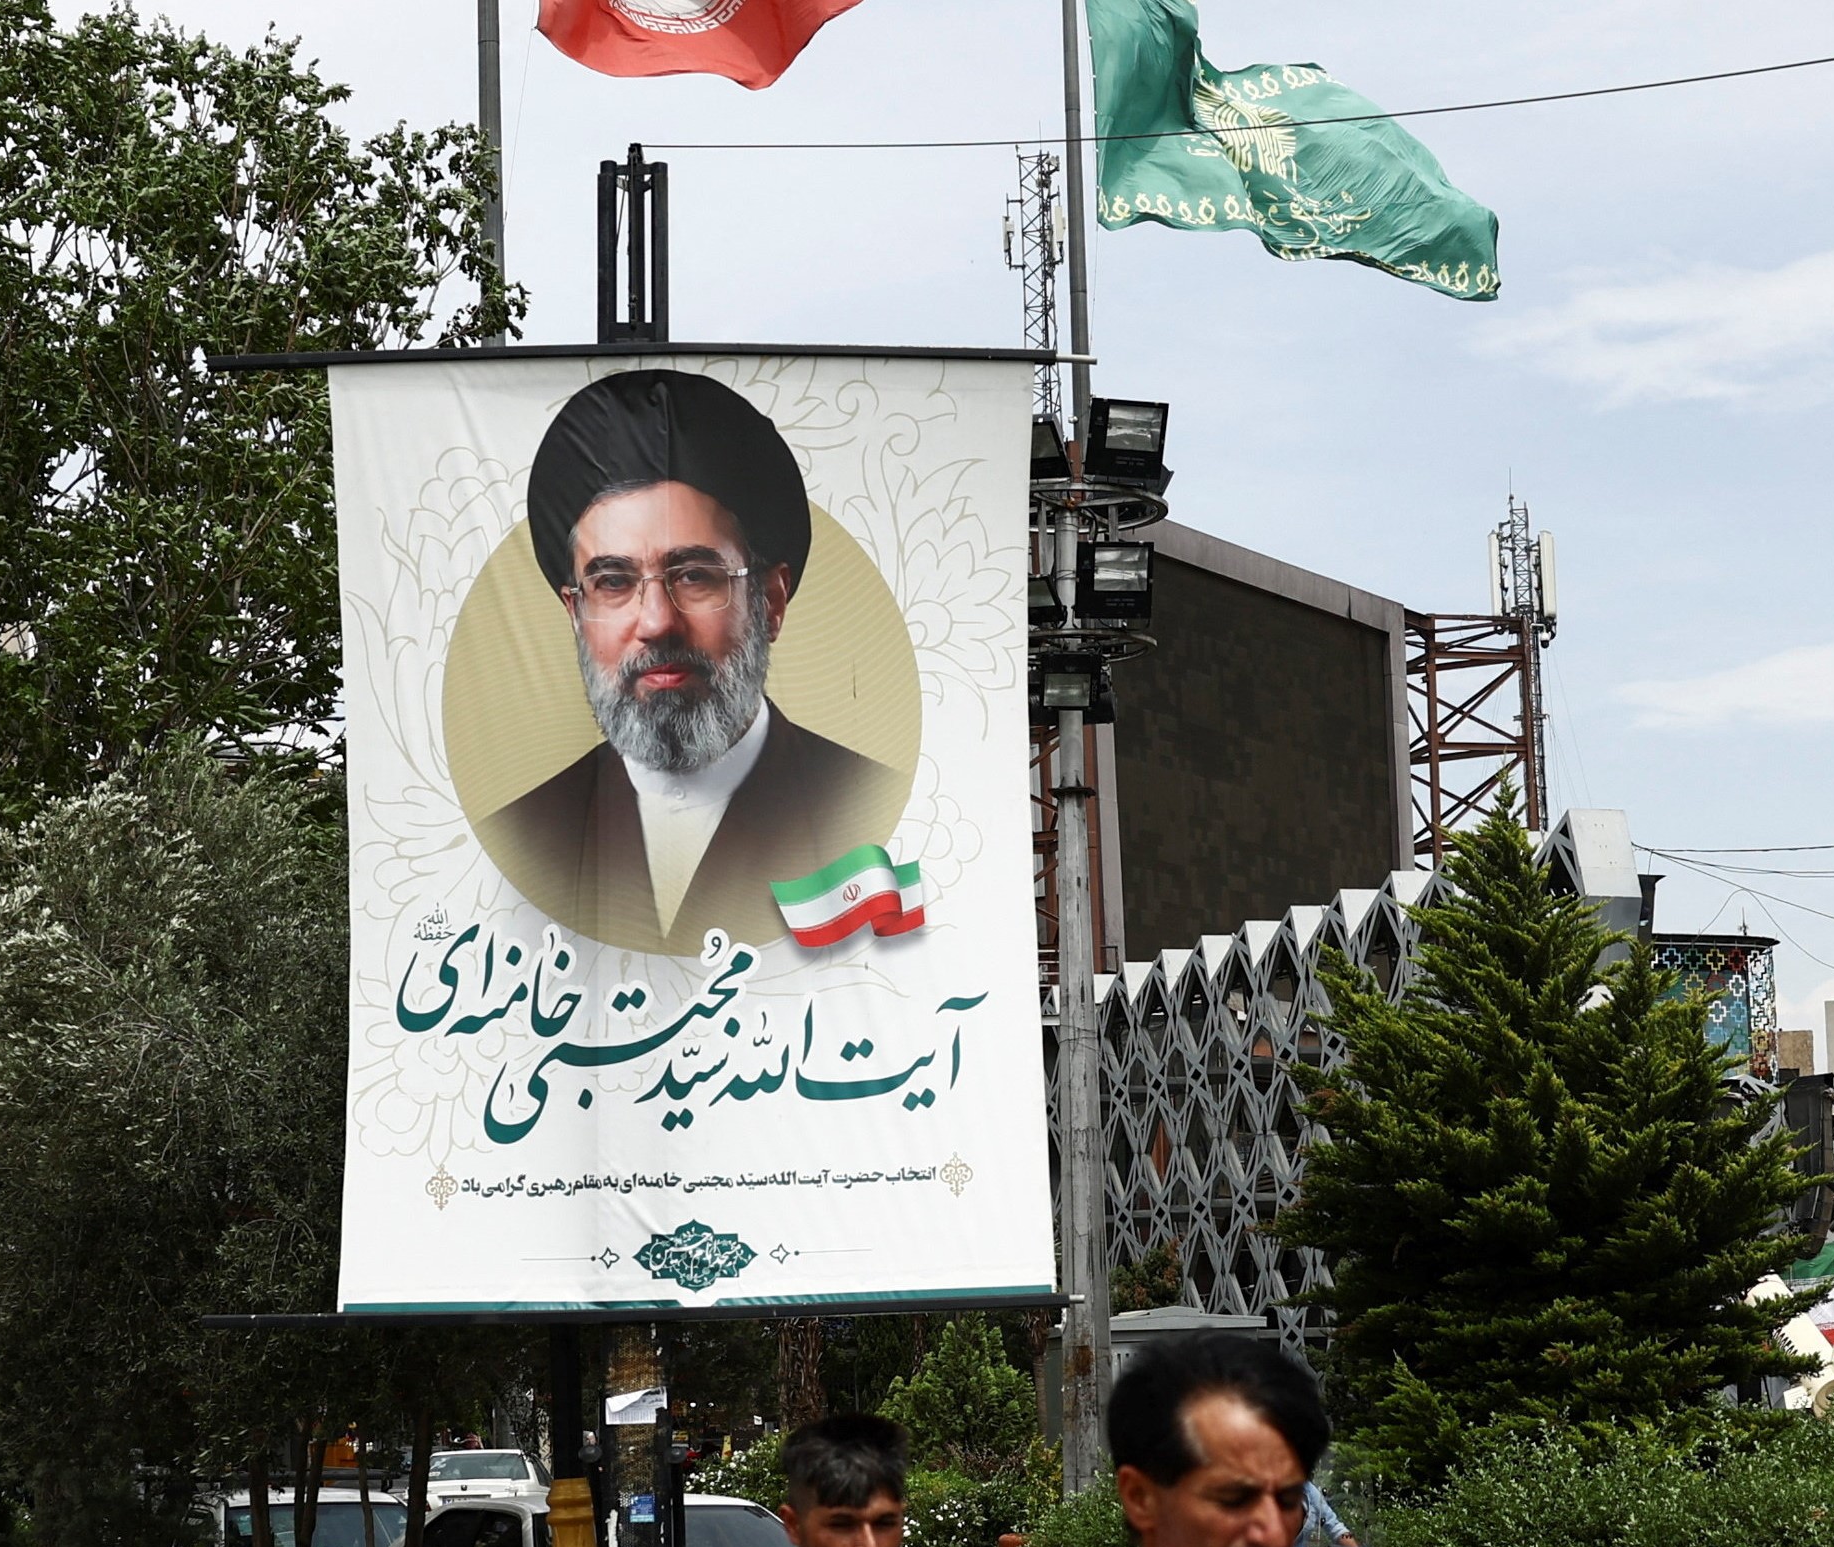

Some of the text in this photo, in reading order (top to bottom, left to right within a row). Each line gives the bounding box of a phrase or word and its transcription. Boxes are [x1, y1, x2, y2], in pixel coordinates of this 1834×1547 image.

[796, 991, 989, 1112] آیت
[603, 1175, 618, 1191] به
[683, 1174, 733, 1193] مجتبی
[769, 1170, 797, 1186] الله
[798, 1169, 831, 1188] آیت
[832, 1169, 884, 1189] حضرت
[885, 1166, 936, 1184] انتخاب
[460, 1178, 481, 1196] باد
[481, 1174, 526, 1198] گرامی
[526, 1178, 572, 1197] رهبری
[572, 1174, 602, 1196] مقام
